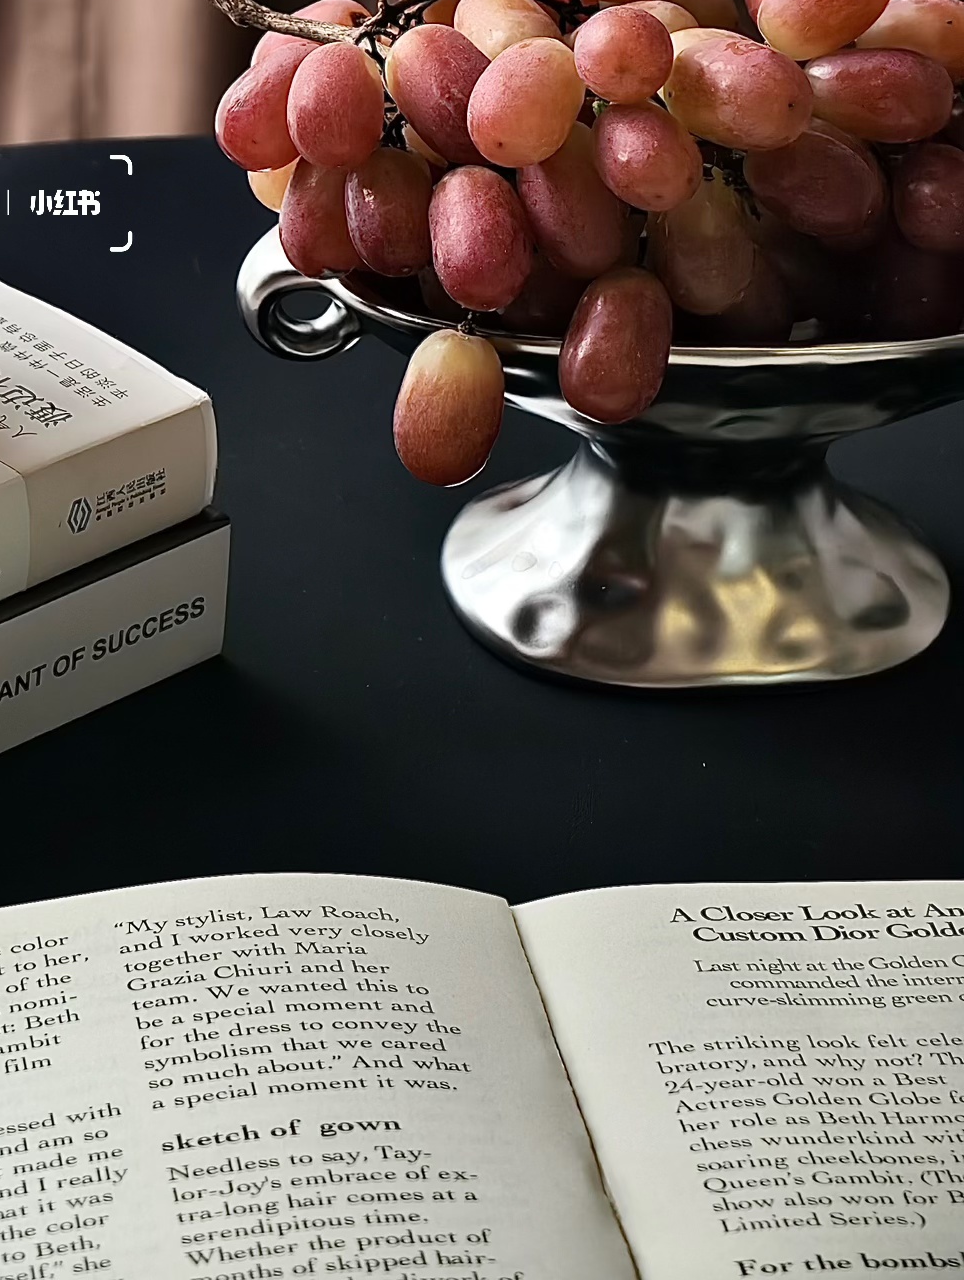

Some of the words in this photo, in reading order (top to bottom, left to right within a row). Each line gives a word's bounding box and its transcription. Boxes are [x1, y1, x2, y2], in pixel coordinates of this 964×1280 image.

[96, 468, 167, 507] 江西人民出版社
[52, 647, 86, 678] OF
[91, 596, 206, 661] SUCCESS
[175, 909, 252, 928] stylist,
[260, 906, 312, 919] Law
[319, 906, 399, 923] Roach,
[670, 908, 697, 923] A
[700, 906, 794, 922] Closer
[797, 904, 881, 921] Look
[886, 906, 916, 918] at
[10, 936, 68, 954] color
[120, 935, 163, 954] and
[171, 933, 181, 947] I
[188, 923, 280, 943] worked
[288, 928, 342, 940] very
[351, 924, 429, 945] closely
[693, 927, 808, 942] Custom
[809, 925, 880, 941] Dior
[14, 962, 36, 973] to
[43, 953, 89, 967] her,
[124, 950, 222, 973] together
[231, 942, 286, 958] with
[294, 942, 368, 955] Maria
[693, 960, 741, 972] Last
[746, 958, 802, 975] night
[806, 962, 828, 972] at
[831, 958, 865, 971] the
[868, 955, 949, 969] Golden
[6, 977, 29, 993] of
[36, 973, 71, 988] the
[127, 970, 207, 991] Grazia
[214, 961, 292, 979] Chiuri
[301, 959, 344, 973] and
[351, 960, 390, 974] her
[730, 974, 861, 989] commanded
[865, 974, 899, 987] the
[9, 990, 77, 1013] nomi-
[132, 995, 197, 1011] team.
[205, 984, 249, 999] We
[258, 978, 348, 994] wanted
[356, 978, 398, 993] this
[405, 984, 429, 995] to
[706, 992, 887, 1009] curve-skimming
[892, 994, 953, 1008] green
[25, 1009, 80, 1030] Beth
[135, 1017, 163, 1030] be
[171, 1016, 185, 1025] a
[193, 1000, 275, 1025] special
[285, 1000, 383, 1012] moment
[391, 1000, 435, 1014] and
[141, 1035, 174, 1050] for
[183, 1028, 220, 1043] the
[228, 1022, 291, 1037] dress
[299, 1021, 323, 1031] to
[332, 1021, 418, 1035] convey
[425, 1019, 461, 1035] the
[5, 1057, 51, 1074] film
[144, 1043, 272, 1072] symbolism
[281, 1037, 328, 1052] that
[337, 1040, 372, 1049] we
[381, 1038, 447, 1052] cared
[148, 1078, 173, 1089] so
[183, 1063, 250, 1084] much
[257, 1055, 341, 1075] about.”
[352, 1054, 403, 1068] And
[412, 1056, 471, 1072] what
[152, 1100, 165, 1109] a
[174, 1081, 258, 1109] special
[268, 1078, 368, 1094] moment
[376, 1074, 394, 1088] it
[404, 1080, 457, 1090] was.
[162, 1124, 260, 1152] sketch
[270, 1119, 301, 1137] of
[320, 1121, 402, 1137] gown
[720, 1212, 822, 1233] Limited
[829, 1211, 926, 1228] Series.)
[734, 1259, 793, 1277] For
[803, 1254, 852, 1271] the
